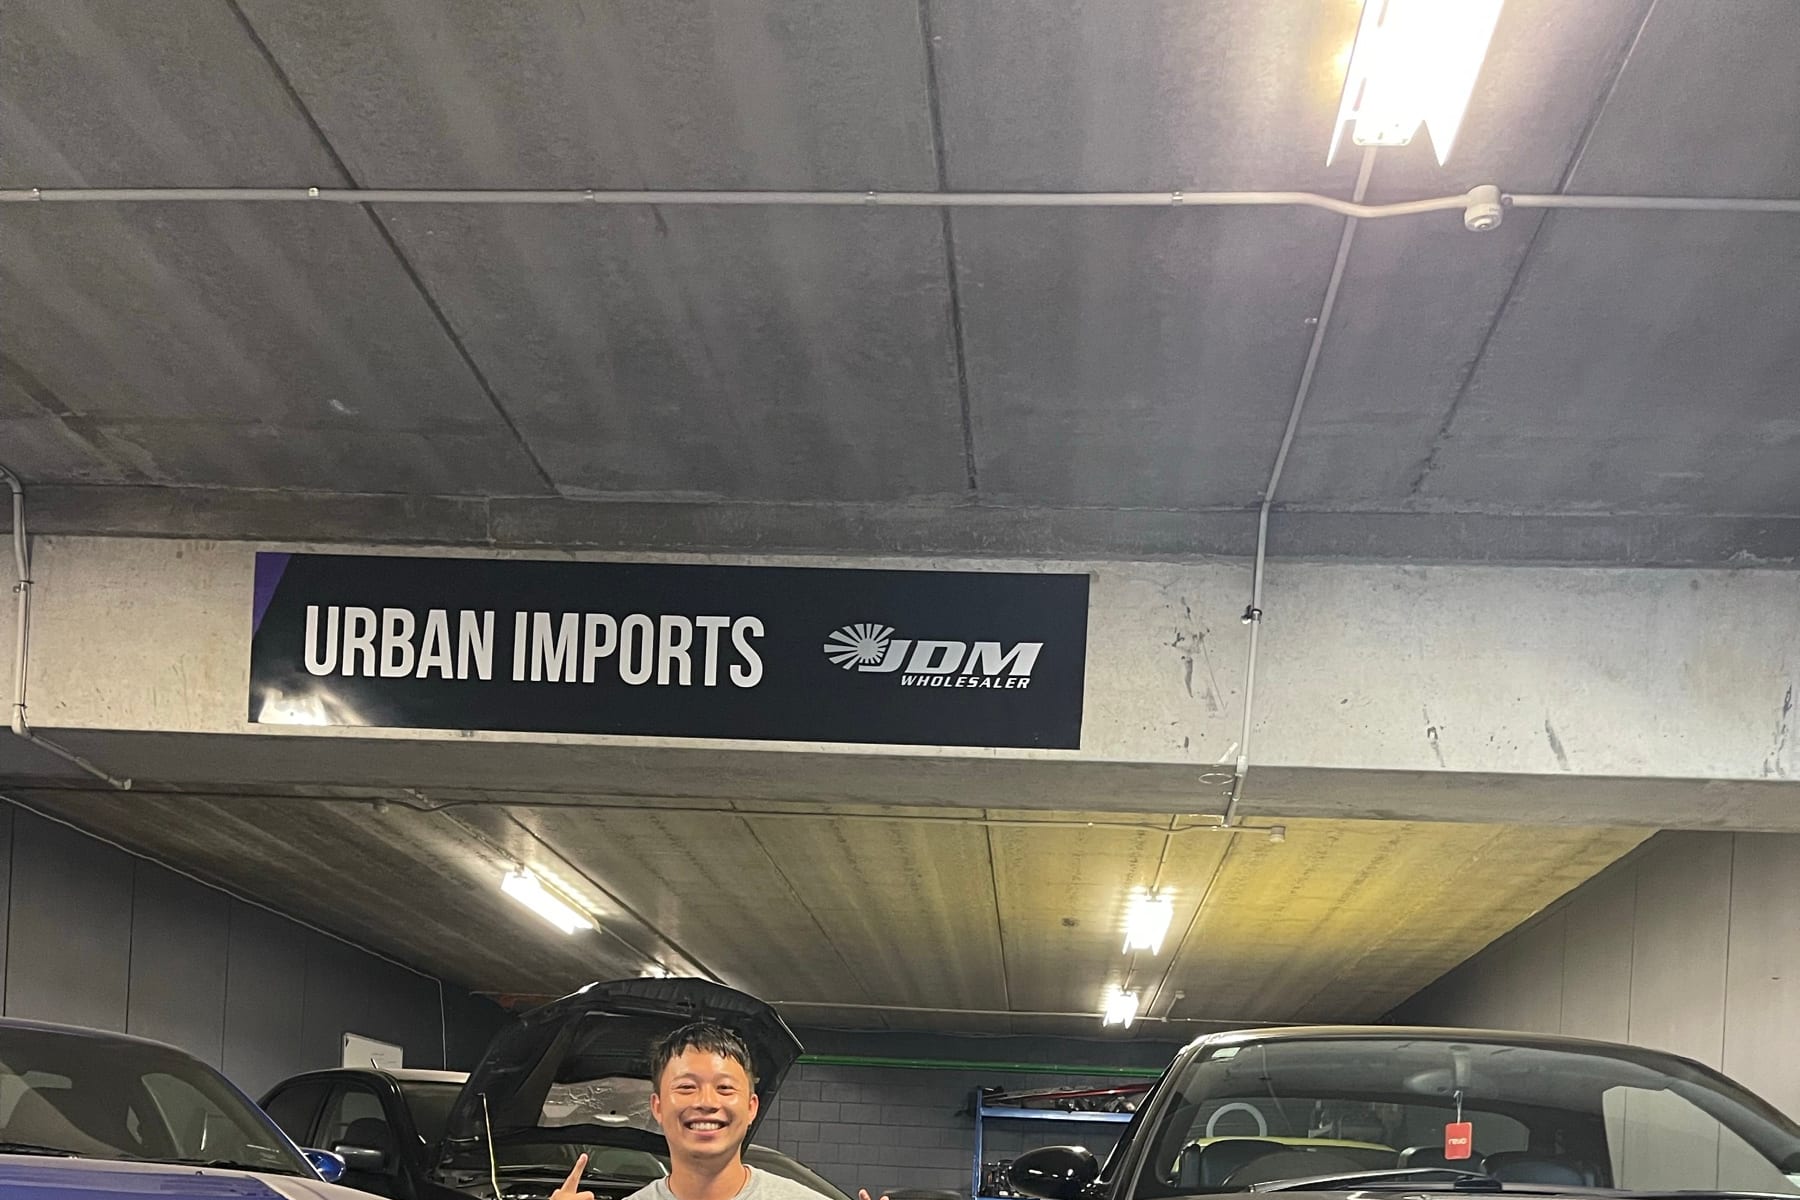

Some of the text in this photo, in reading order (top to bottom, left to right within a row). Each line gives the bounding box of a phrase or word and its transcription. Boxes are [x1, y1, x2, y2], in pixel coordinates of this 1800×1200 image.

[304, 605, 766, 688] URBAN IMPORTS
[858, 639, 1044, 676] JDM
[900, 675, 1031, 689] WHOLESALER
